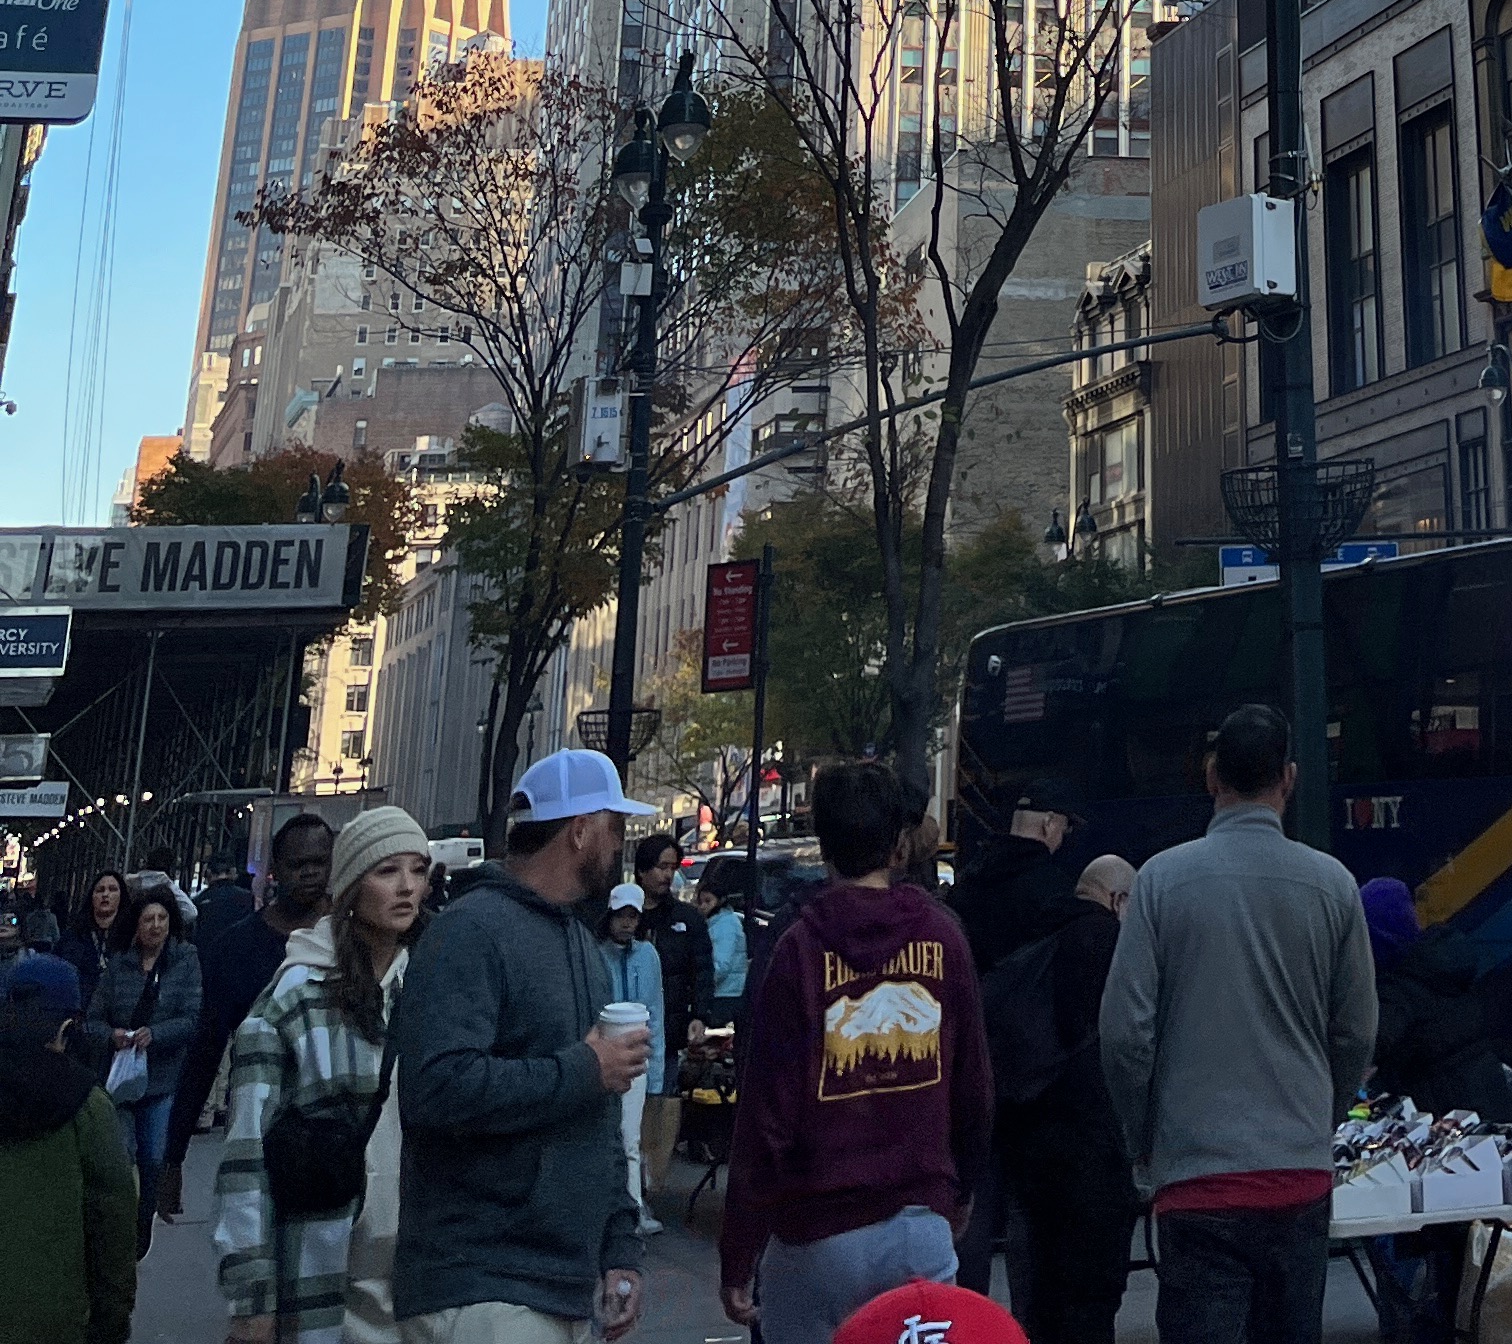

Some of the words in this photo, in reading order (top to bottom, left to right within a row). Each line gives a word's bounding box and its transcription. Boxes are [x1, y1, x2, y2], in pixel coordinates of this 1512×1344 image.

[140, 538, 325, 593] MADDEN
[29, 793, 66, 805] MADDEN
[1371, 795, 1404, 829] NY
